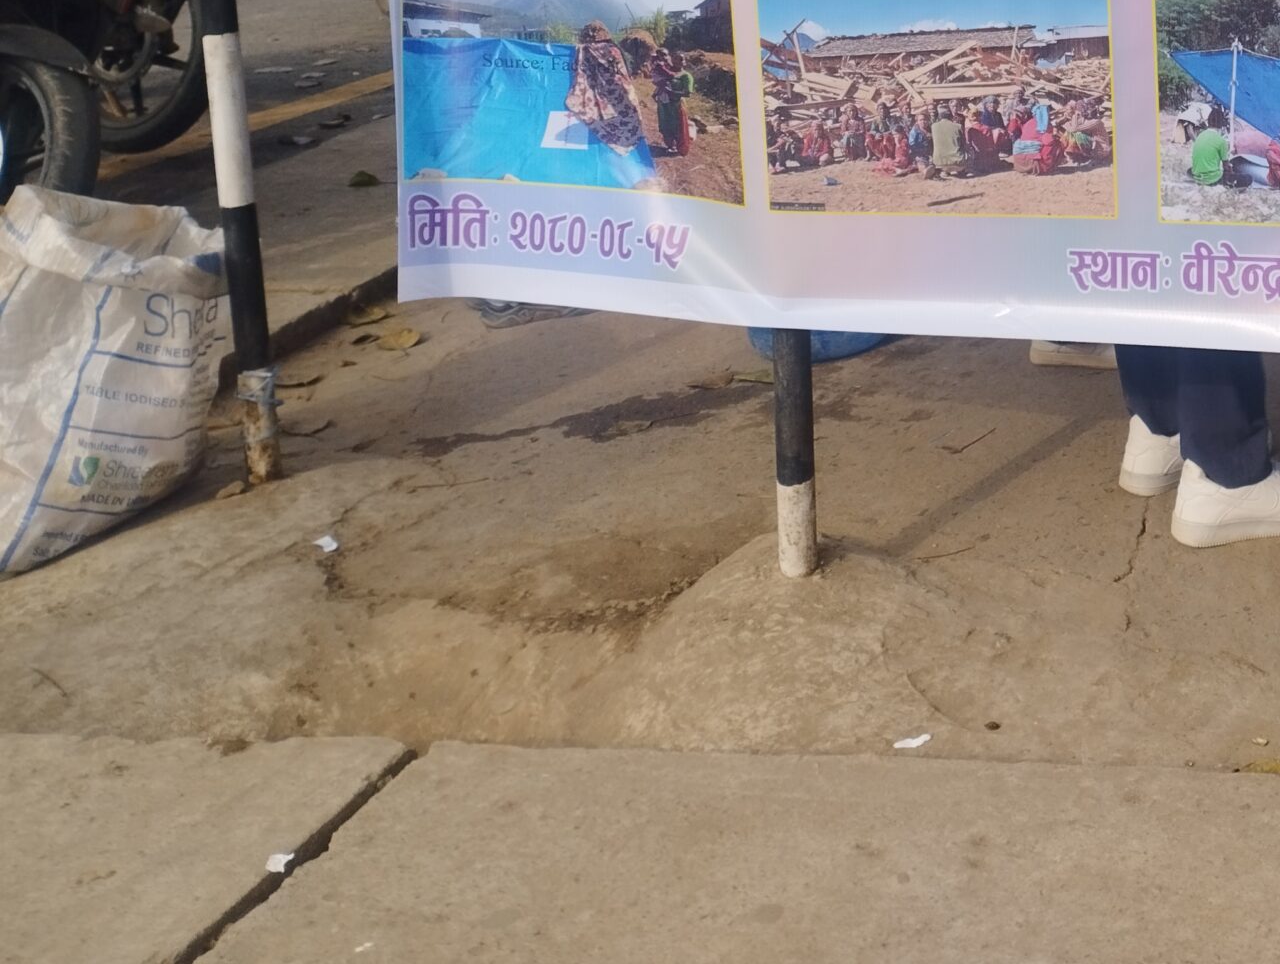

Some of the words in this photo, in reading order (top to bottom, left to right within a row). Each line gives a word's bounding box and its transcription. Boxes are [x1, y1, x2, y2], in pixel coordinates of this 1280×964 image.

[482, 52, 544, 71] Source:
[510, 210, 690, 270] २०८०-०८-१५
[135, 340, 190, 358] REFINED
[124, 392, 178, 409] IODISED
